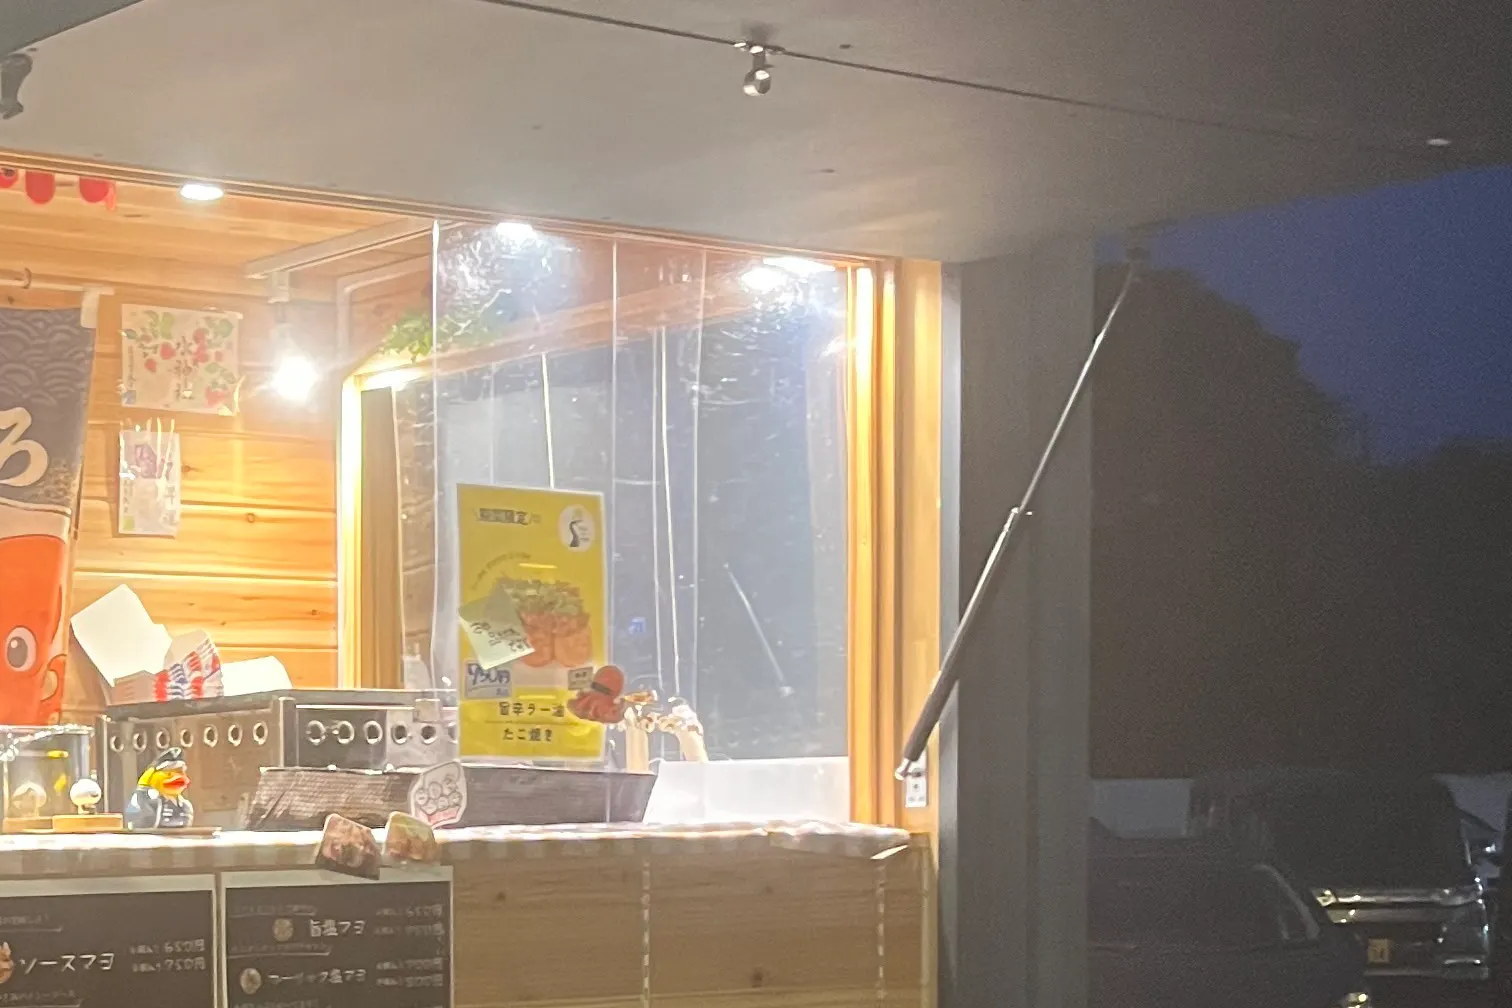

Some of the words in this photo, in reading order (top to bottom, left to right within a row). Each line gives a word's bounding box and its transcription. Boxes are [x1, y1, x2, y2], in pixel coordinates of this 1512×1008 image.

[503, 727, 553, 741] たこ焼き
[19, 952, 115, 975] ソースマヨ
